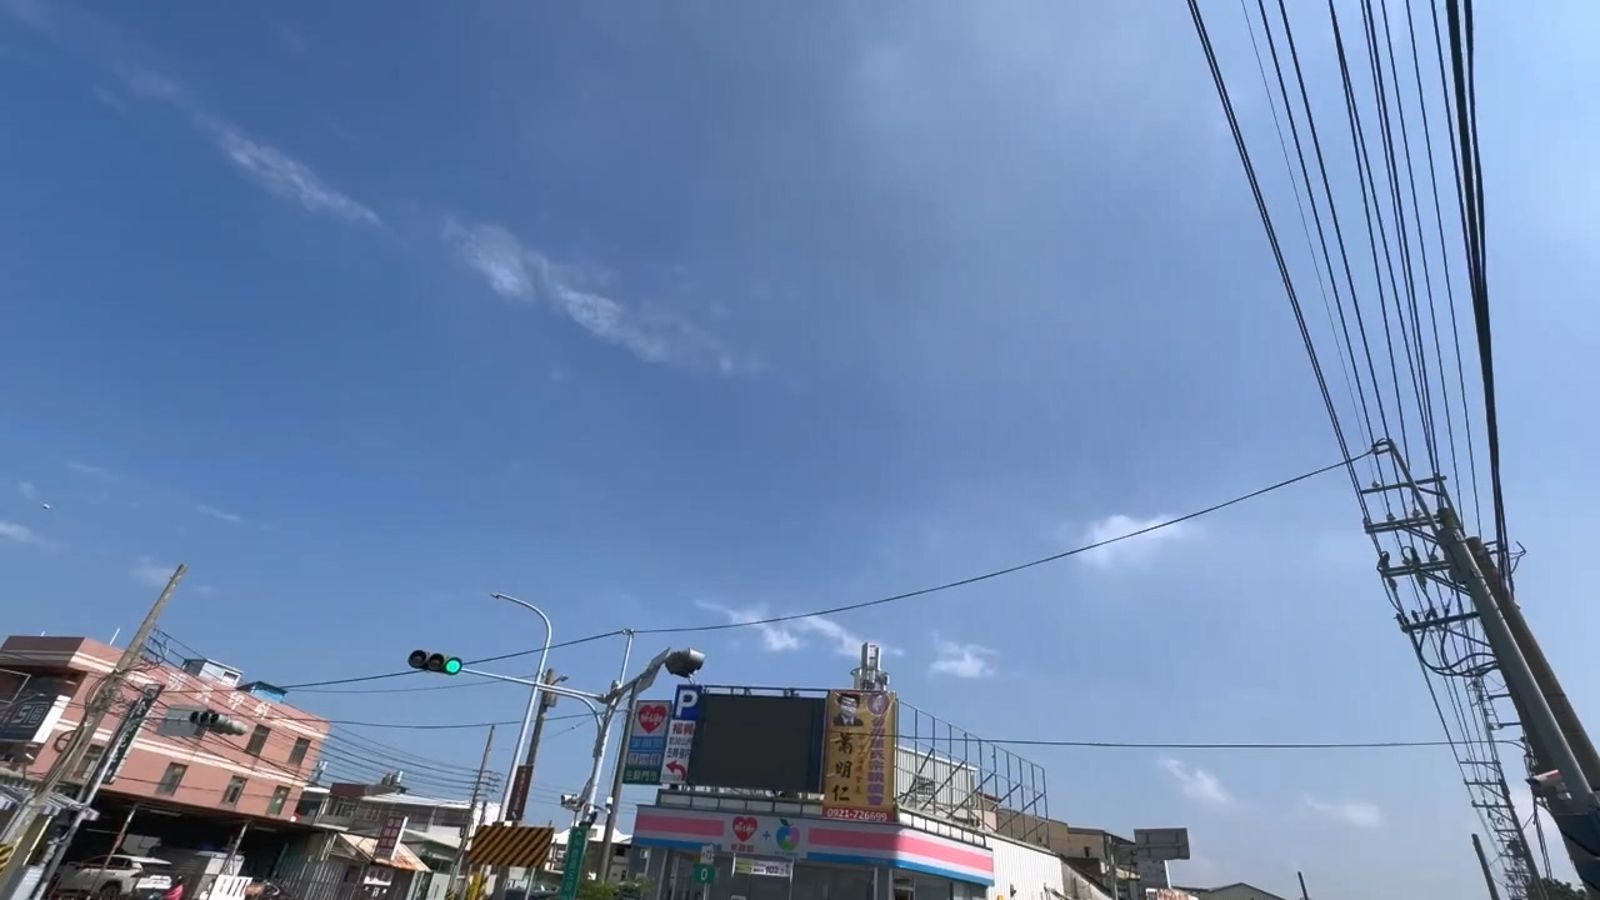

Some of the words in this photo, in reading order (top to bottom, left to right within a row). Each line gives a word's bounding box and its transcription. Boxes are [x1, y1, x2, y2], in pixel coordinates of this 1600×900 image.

[676, 689, 698, 718] P
[826, 808, 887, 822] 0921-726699
[700, 868, 708, 881] 0
